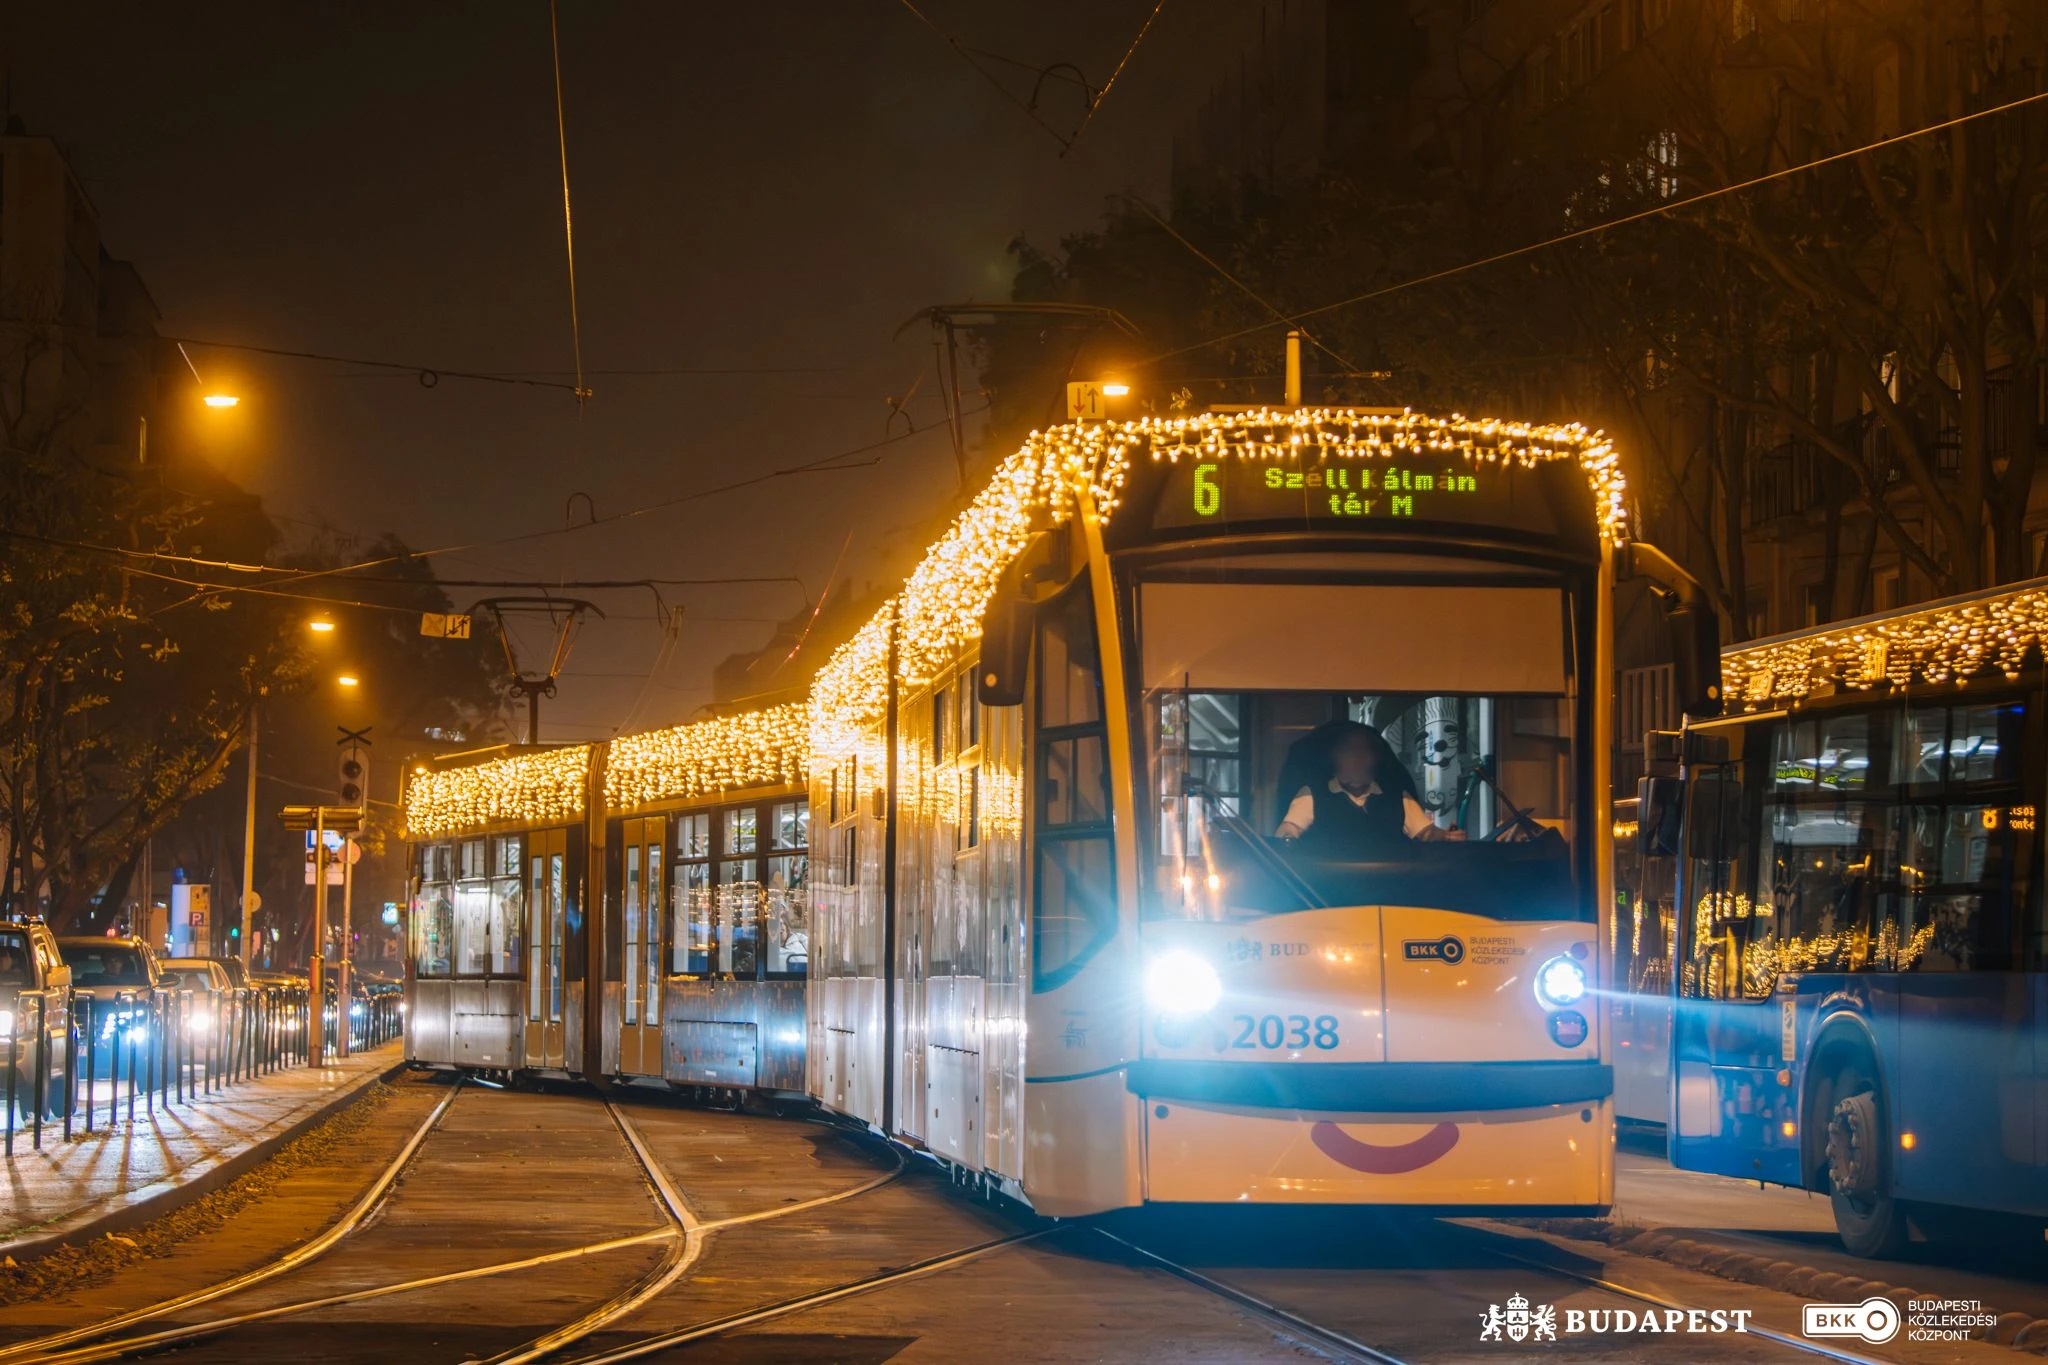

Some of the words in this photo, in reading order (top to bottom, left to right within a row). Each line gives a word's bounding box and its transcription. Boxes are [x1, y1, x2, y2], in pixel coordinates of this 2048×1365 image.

[1194, 464, 1221, 516] 6
[1265, 465, 1350, 490] Széll
[1329, 491, 1381, 516] tér
[1391, 494, 1413, 516] M
[1410, 945, 1438, 956] BKK
[1231, 1014, 1340, 1050] 2038
